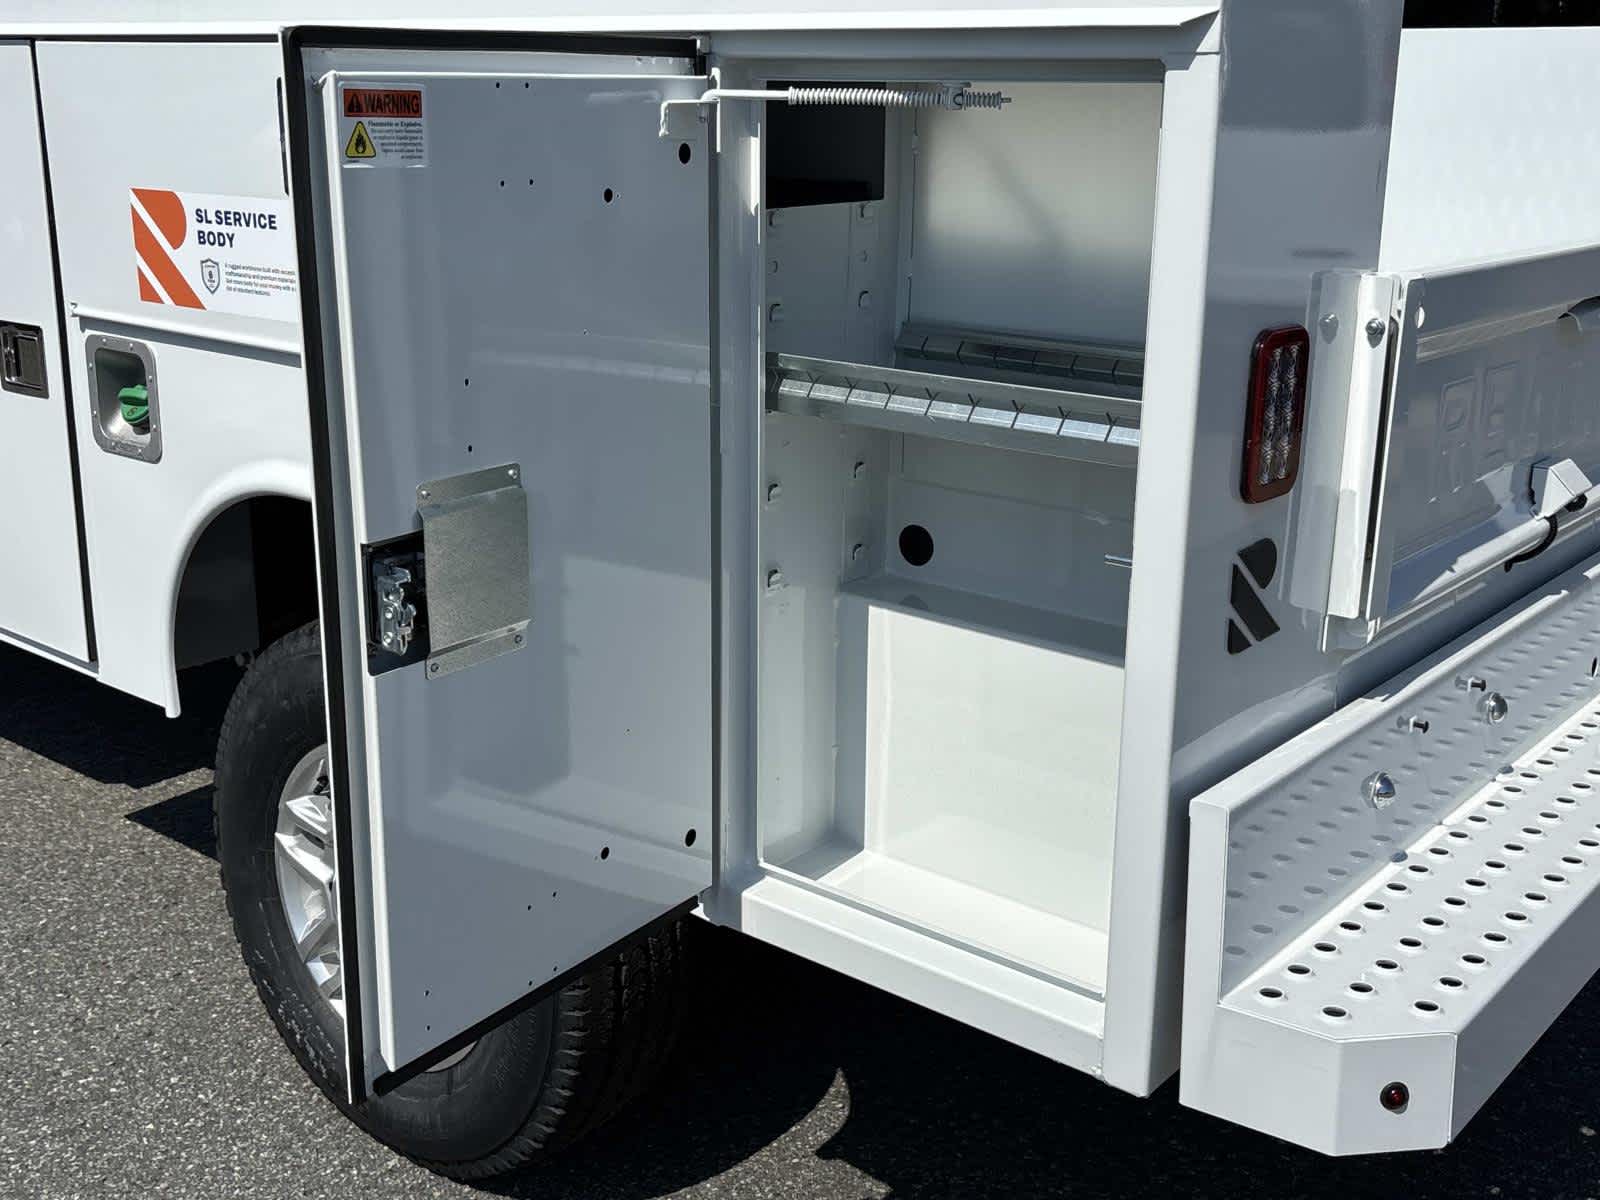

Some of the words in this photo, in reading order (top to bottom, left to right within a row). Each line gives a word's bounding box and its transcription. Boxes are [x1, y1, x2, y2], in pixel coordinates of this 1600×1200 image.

[364, 93, 419, 113] WARNING
[195, 208, 212, 224] SL
[215, 209, 277, 230] SERVICE
[197, 230, 235, 248] BODY
